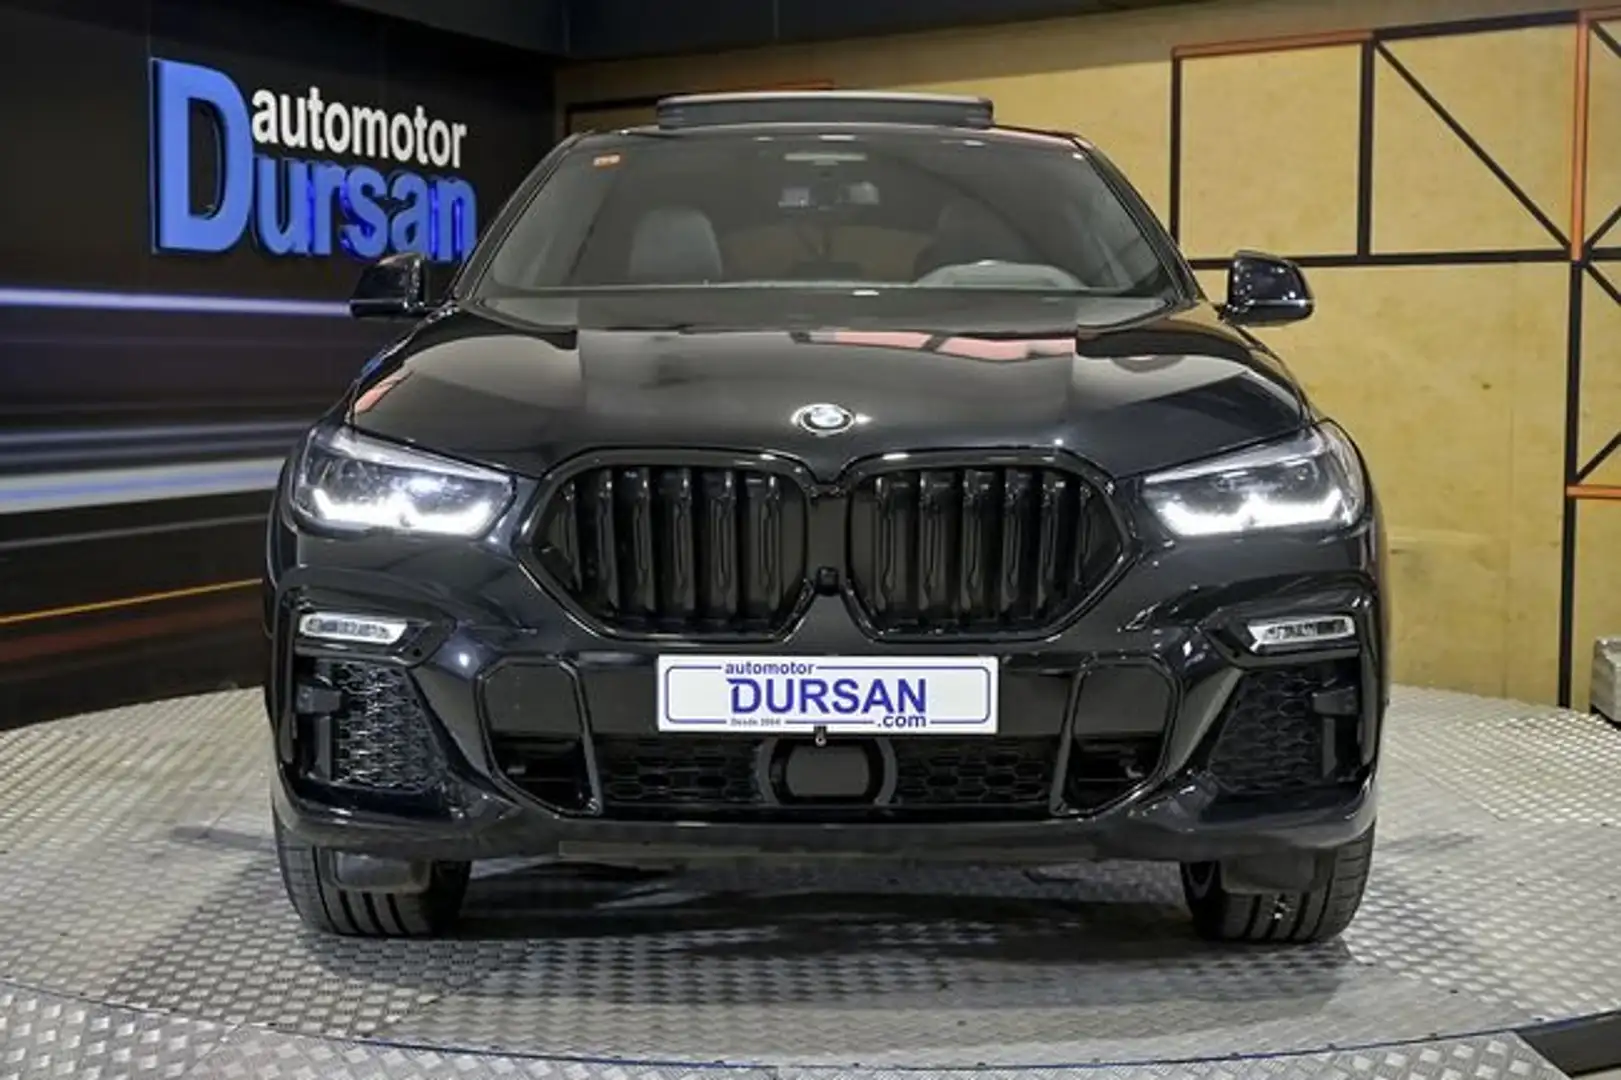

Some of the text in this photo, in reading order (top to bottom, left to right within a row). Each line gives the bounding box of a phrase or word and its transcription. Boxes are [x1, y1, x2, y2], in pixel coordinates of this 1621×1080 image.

[252, 86, 467, 168] automotor
[151, 58, 477, 263] Dursan
[725, 661, 814, 675] automotor
[727, 678, 926, 714] DURSAN
[877, 715, 927, 728] .com
